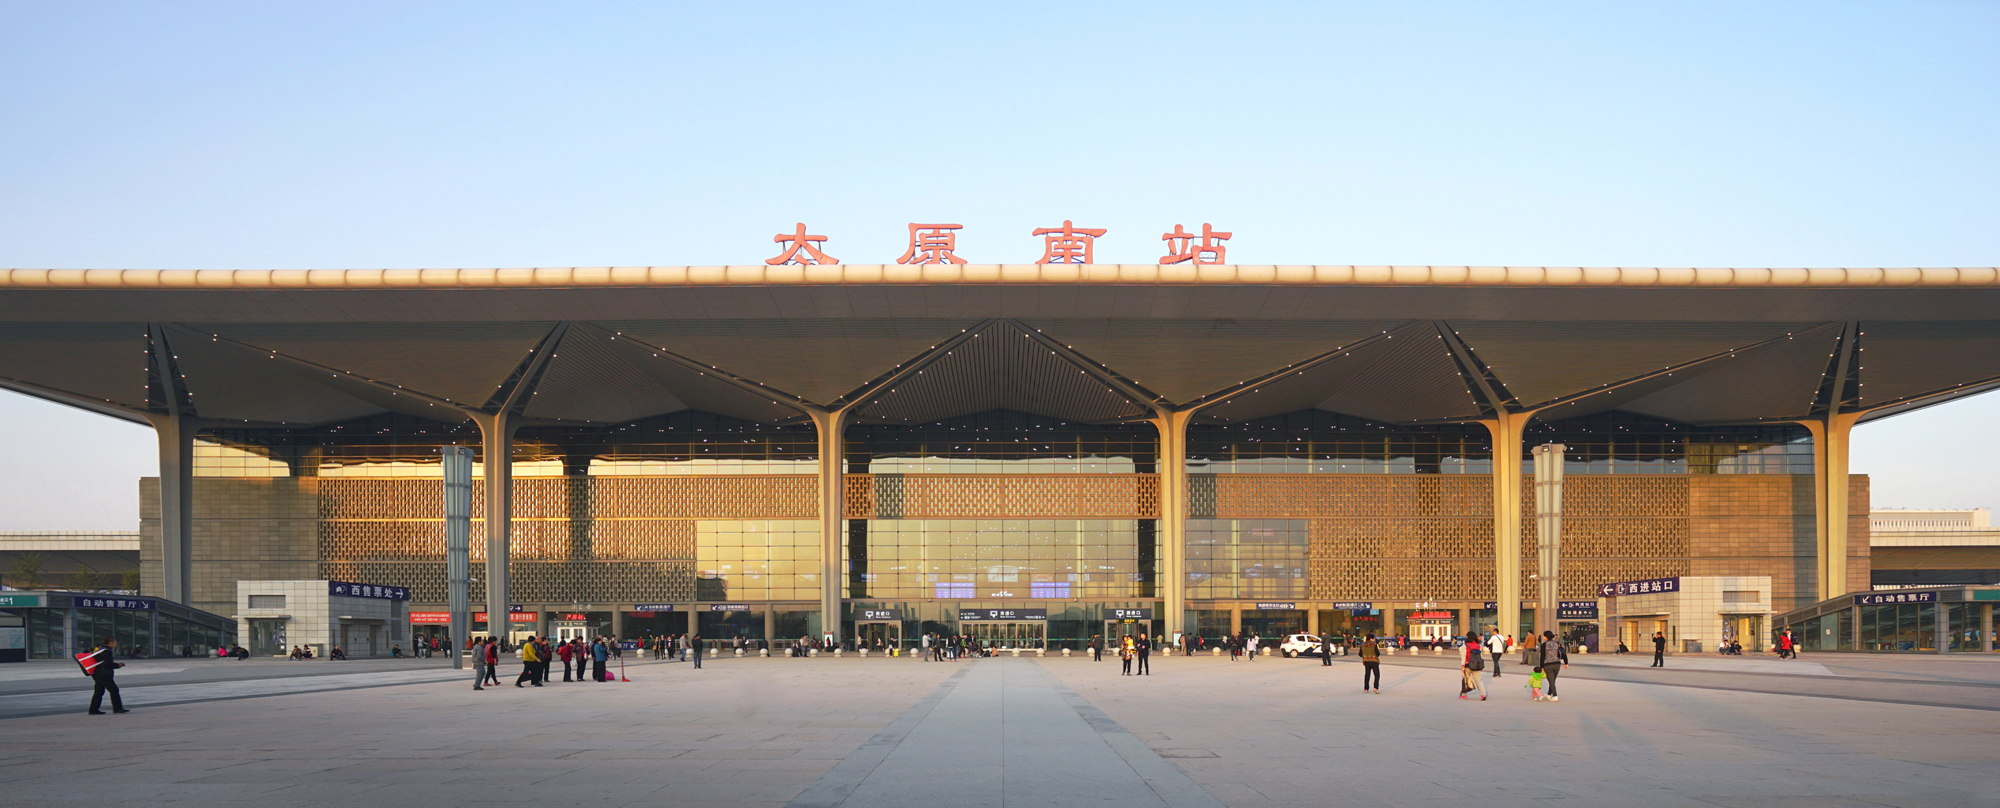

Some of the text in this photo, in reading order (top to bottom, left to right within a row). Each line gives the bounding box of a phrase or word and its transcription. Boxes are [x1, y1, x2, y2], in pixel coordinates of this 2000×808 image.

[765, 219, 1233, 265] 太原南站
[351, 585, 393, 598] 西售票处
[1629, 581, 1673, 593] 西进站口
[83, 599, 137, 608] 自动售票厅
[1875, 593, 1930, 603] 自动售票厅
